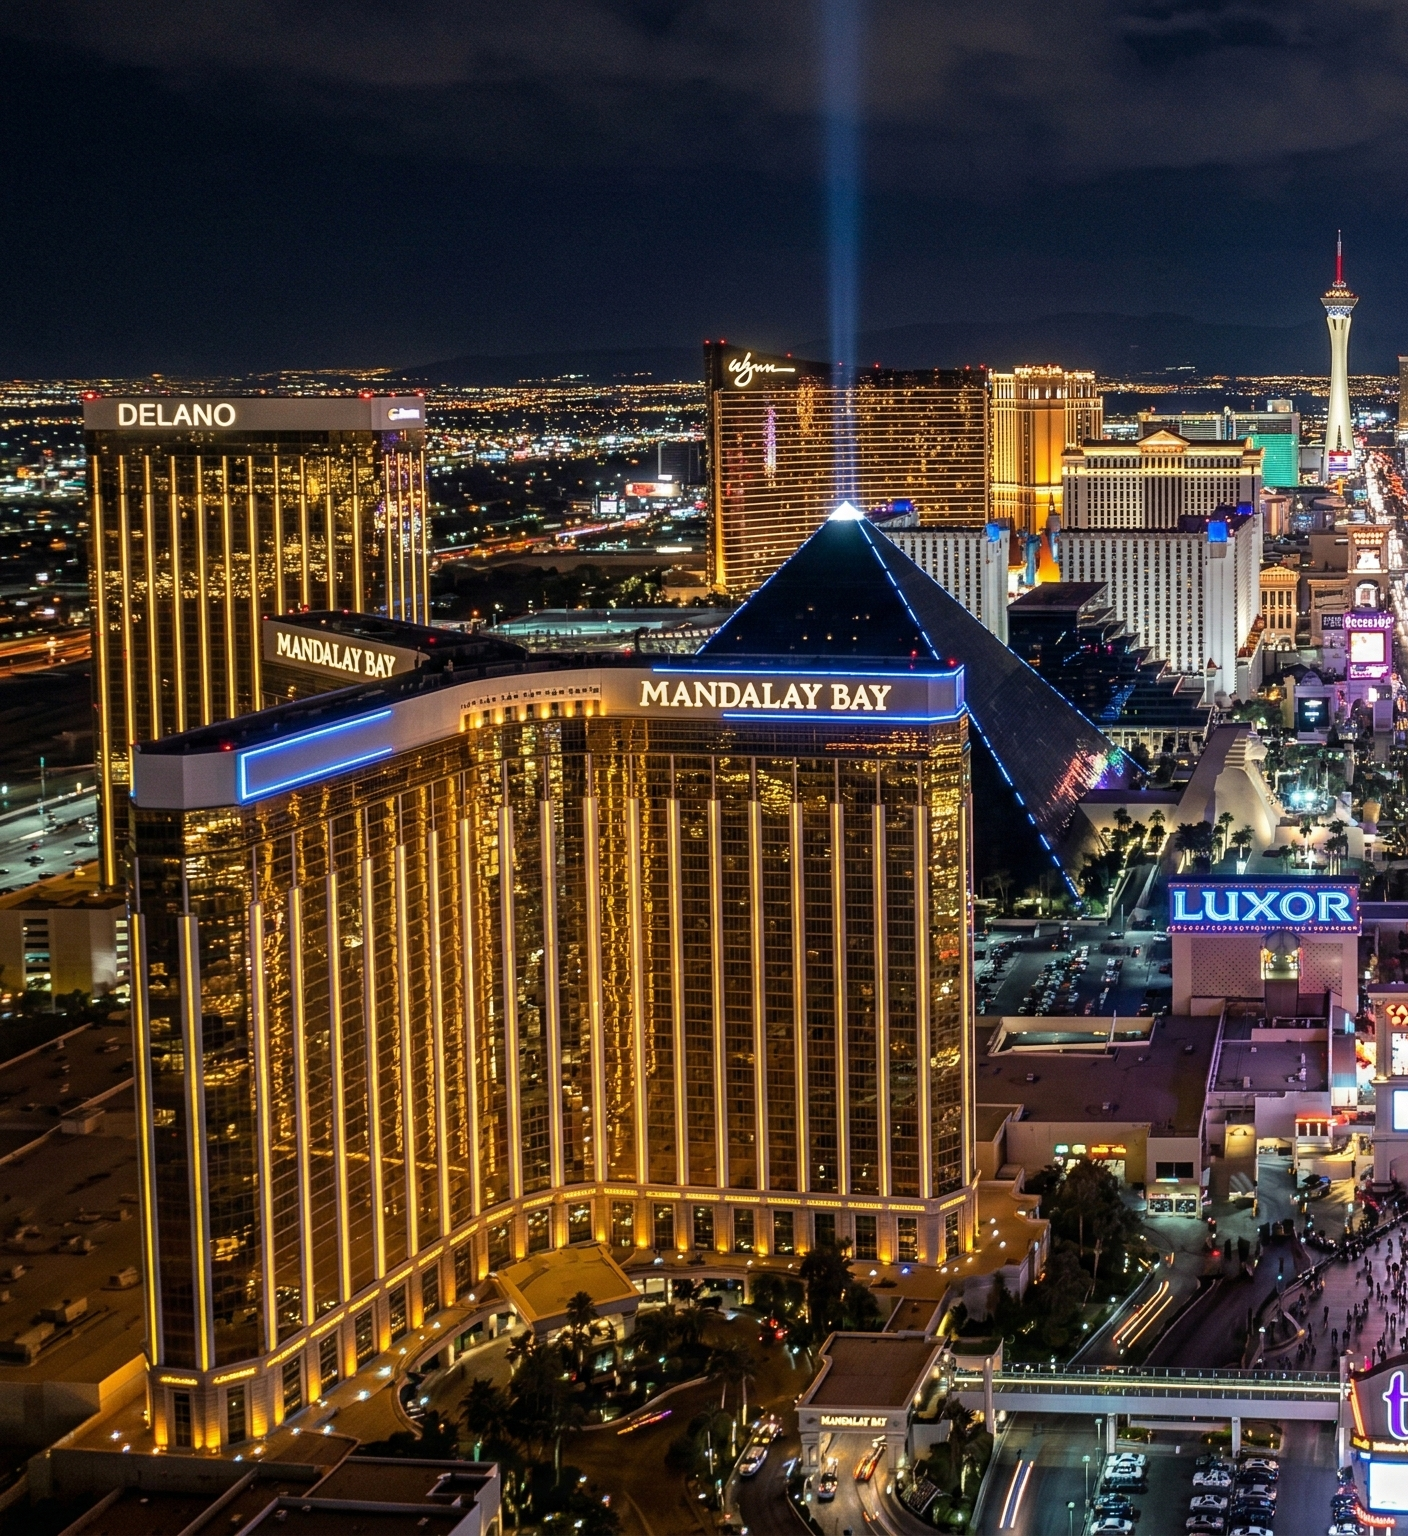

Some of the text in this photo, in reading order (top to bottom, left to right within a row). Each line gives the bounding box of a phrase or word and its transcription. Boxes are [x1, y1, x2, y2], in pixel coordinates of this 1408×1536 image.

[118, 403, 236, 427] DELANO
[276, 632, 396, 678] MANDALAY BAY
[639, 681, 892, 711] MANDALAY BAY
[1173, 891, 1354, 922] LUXOR
